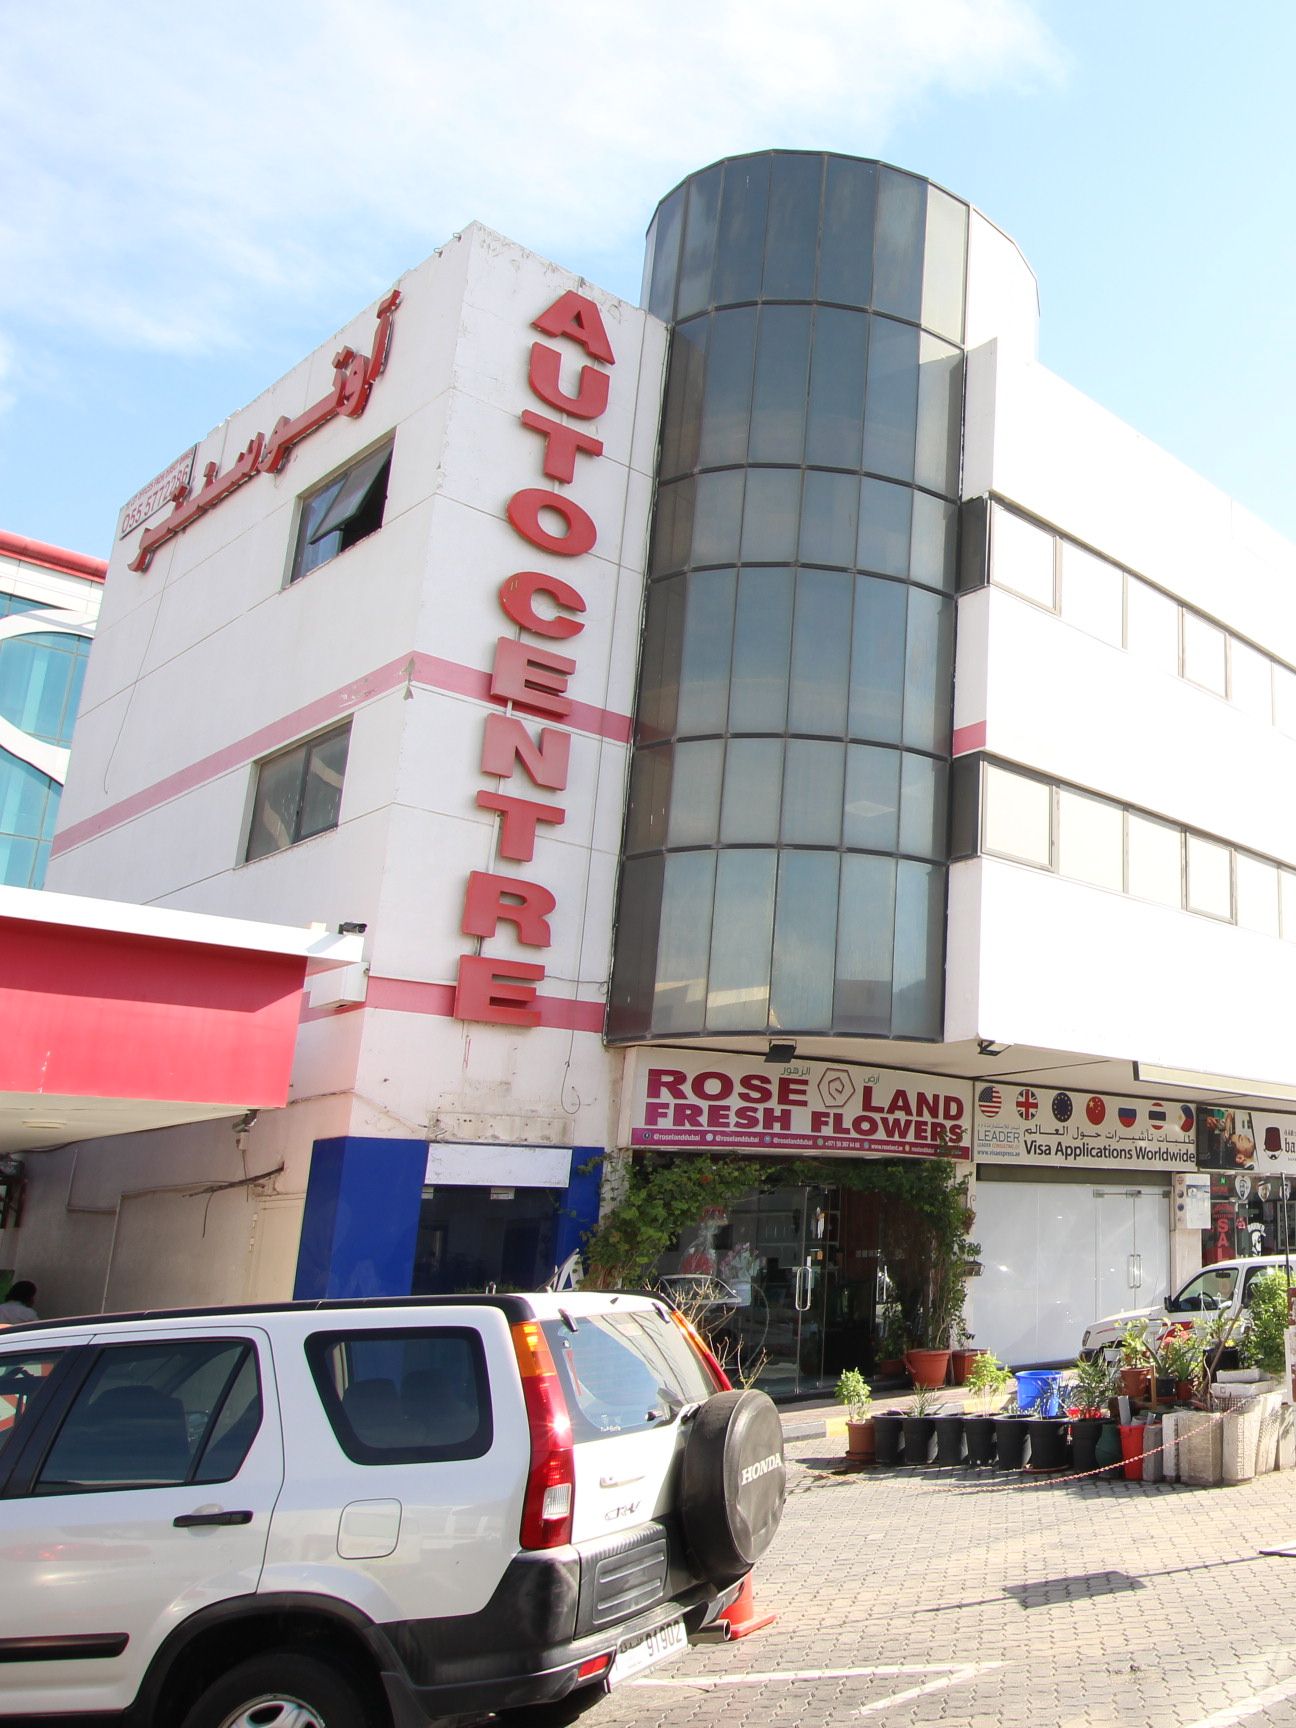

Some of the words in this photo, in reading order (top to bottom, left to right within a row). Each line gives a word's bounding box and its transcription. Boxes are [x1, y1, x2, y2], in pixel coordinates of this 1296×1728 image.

[646, 1068, 809, 1107] ROSE
[861, 1085, 965, 1121] LAND
[644, 1102, 792, 1131] FRESH
[810, 1110, 964, 1144] FLOWERS
[977, 1129, 1021, 1143] LEADER
[1023, 1123, 1069, 1138] العالم
[1072, 1127, 1102, 1140] حول
[1024, 1139, 1051, 1156] Visa
[1055, 1141, 1133, 1161] Applications
[1135, 1145, 1196, 1163] Worldwide
[741, 1453, 782, 1486] HONDA
[645, 1619, 683, 1657] 91902
